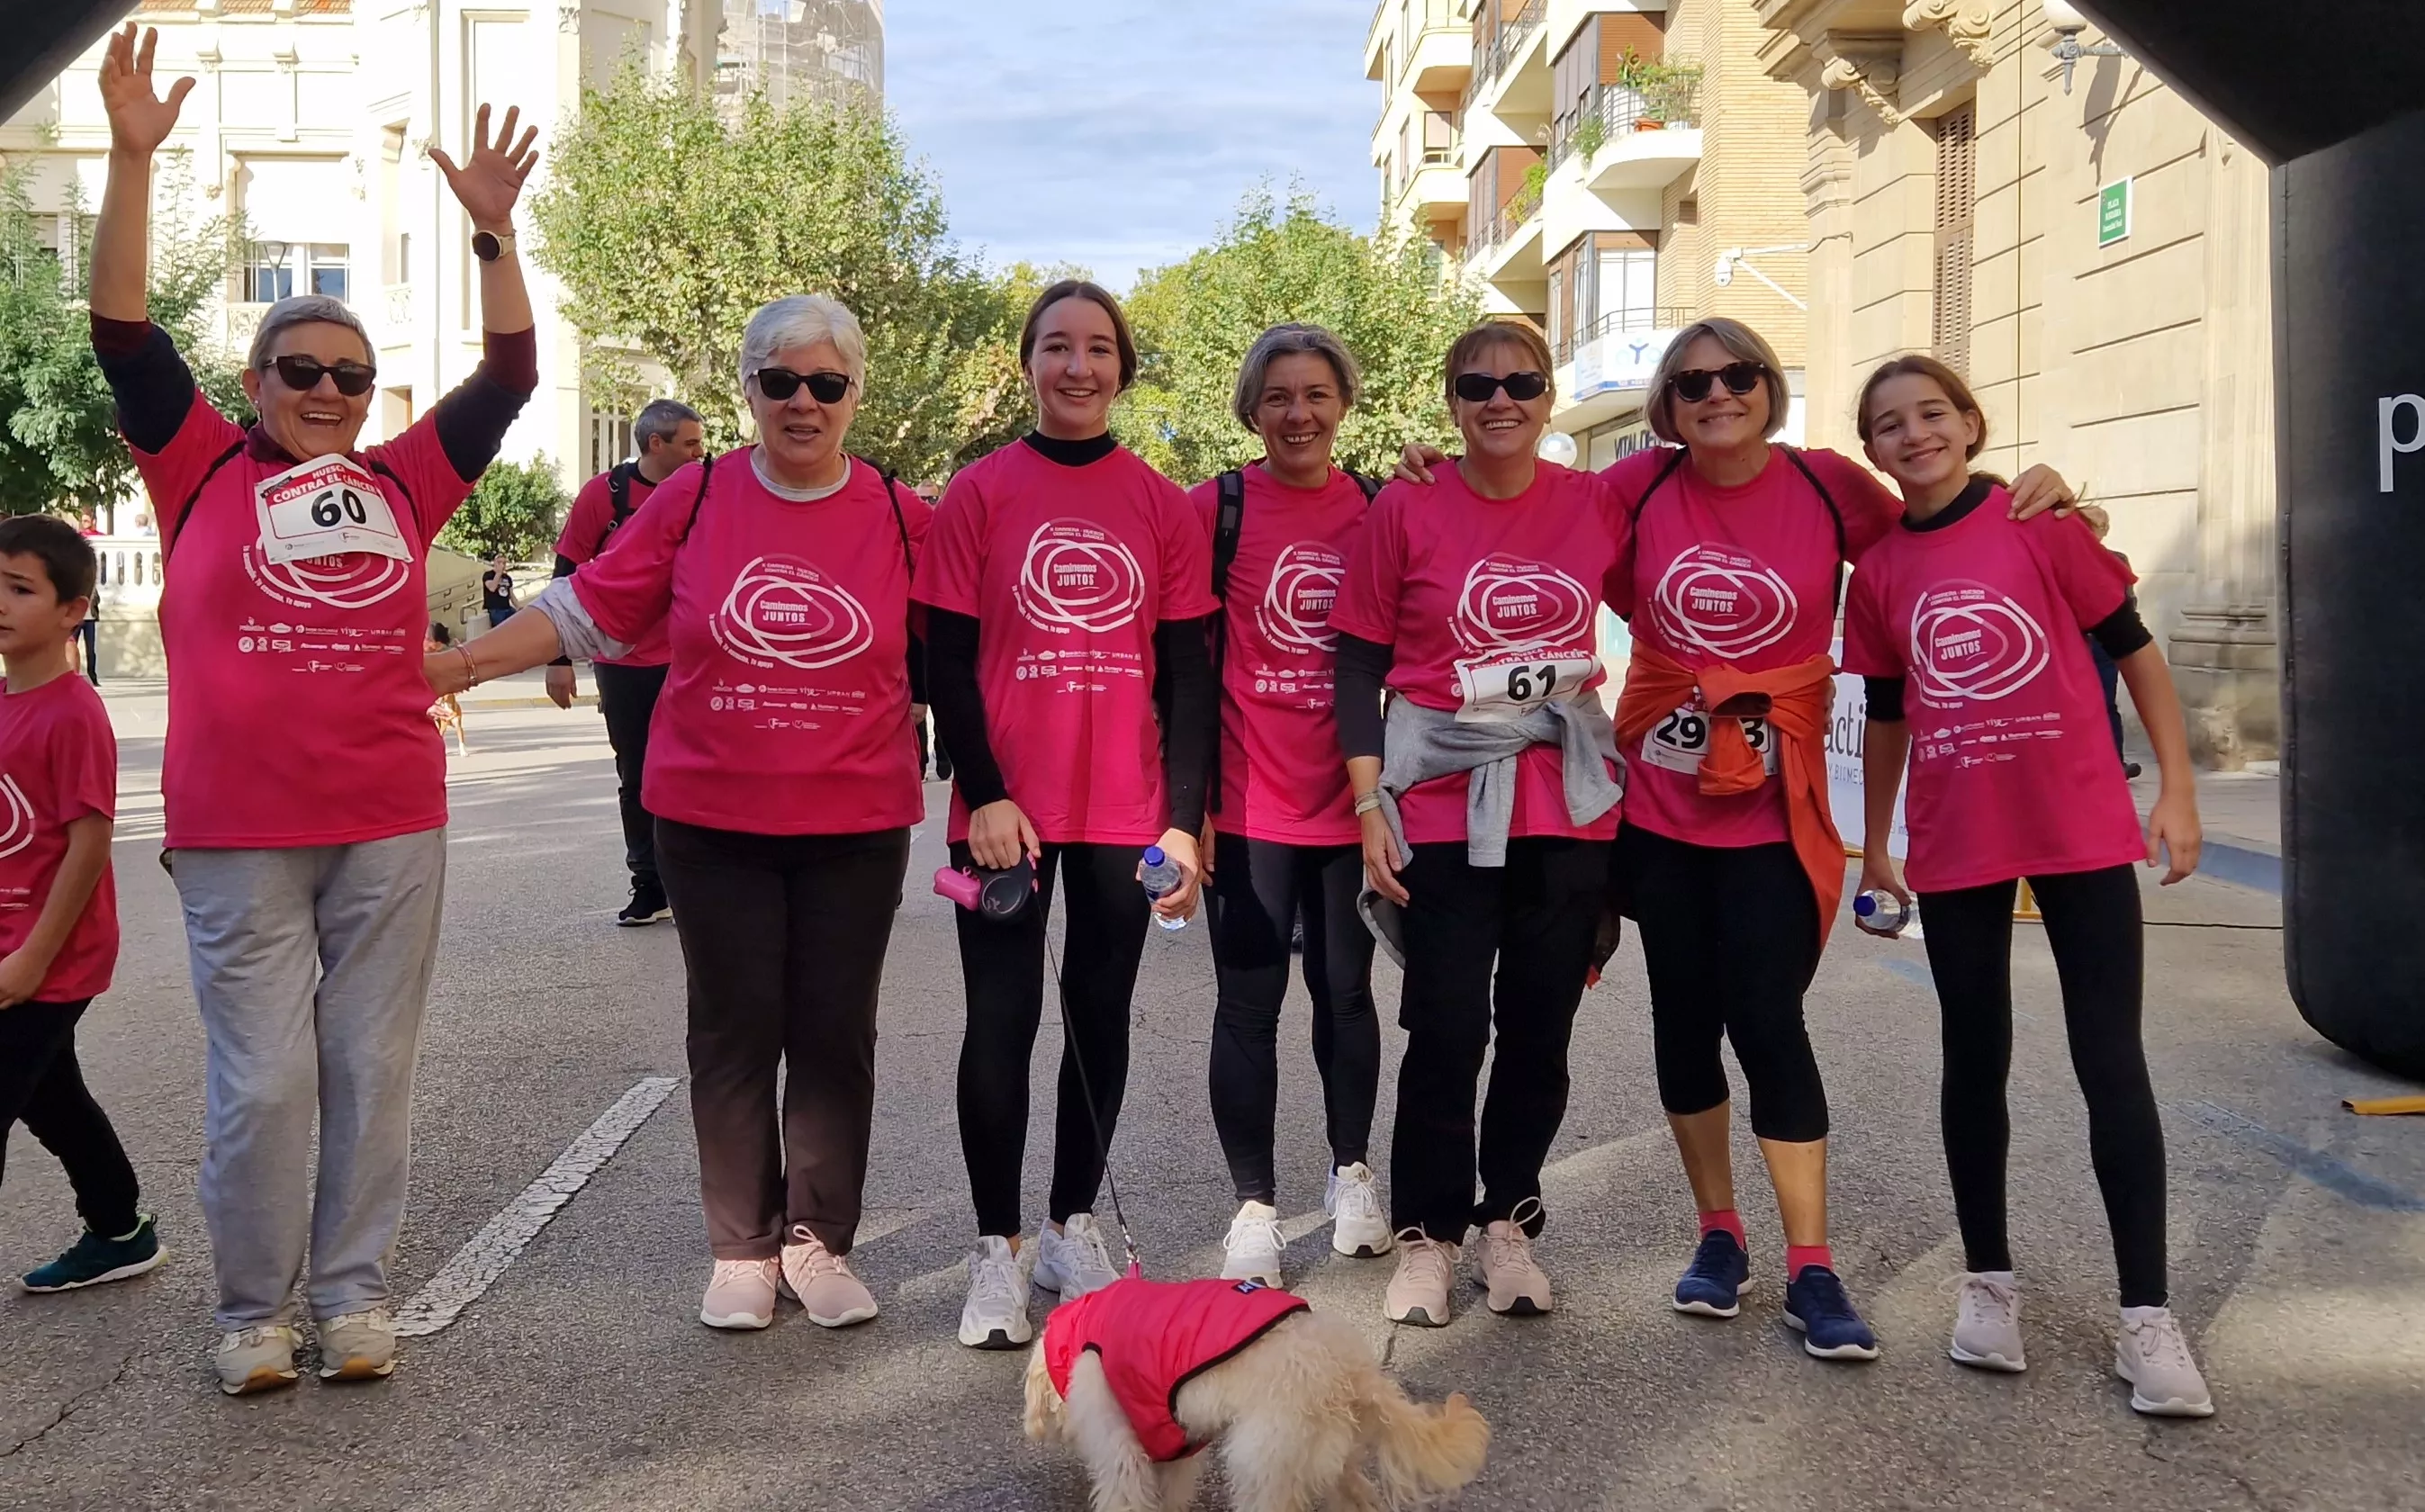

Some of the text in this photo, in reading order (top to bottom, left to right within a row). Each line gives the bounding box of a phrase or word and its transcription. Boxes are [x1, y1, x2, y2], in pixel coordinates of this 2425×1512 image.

[2378, 393, 2425, 492] p
[273, 478, 325, 504] CONTRA
[326, 472, 341, 483] EL
[311, 489, 367, 526] 60
[1057, 573, 1094, 587] JUNTOS
[1300, 598, 1334, 610] JUNTOS
[1497, 603, 1537, 618] JUNTOS
[1691, 598, 1734, 613] JUNTOS
[762, 611, 805, 623] JUNTOS
[1941, 640, 1980, 661] JUNTOS
[1508, 664, 1555, 701] 61
[1826, 701, 1863, 758] cti
